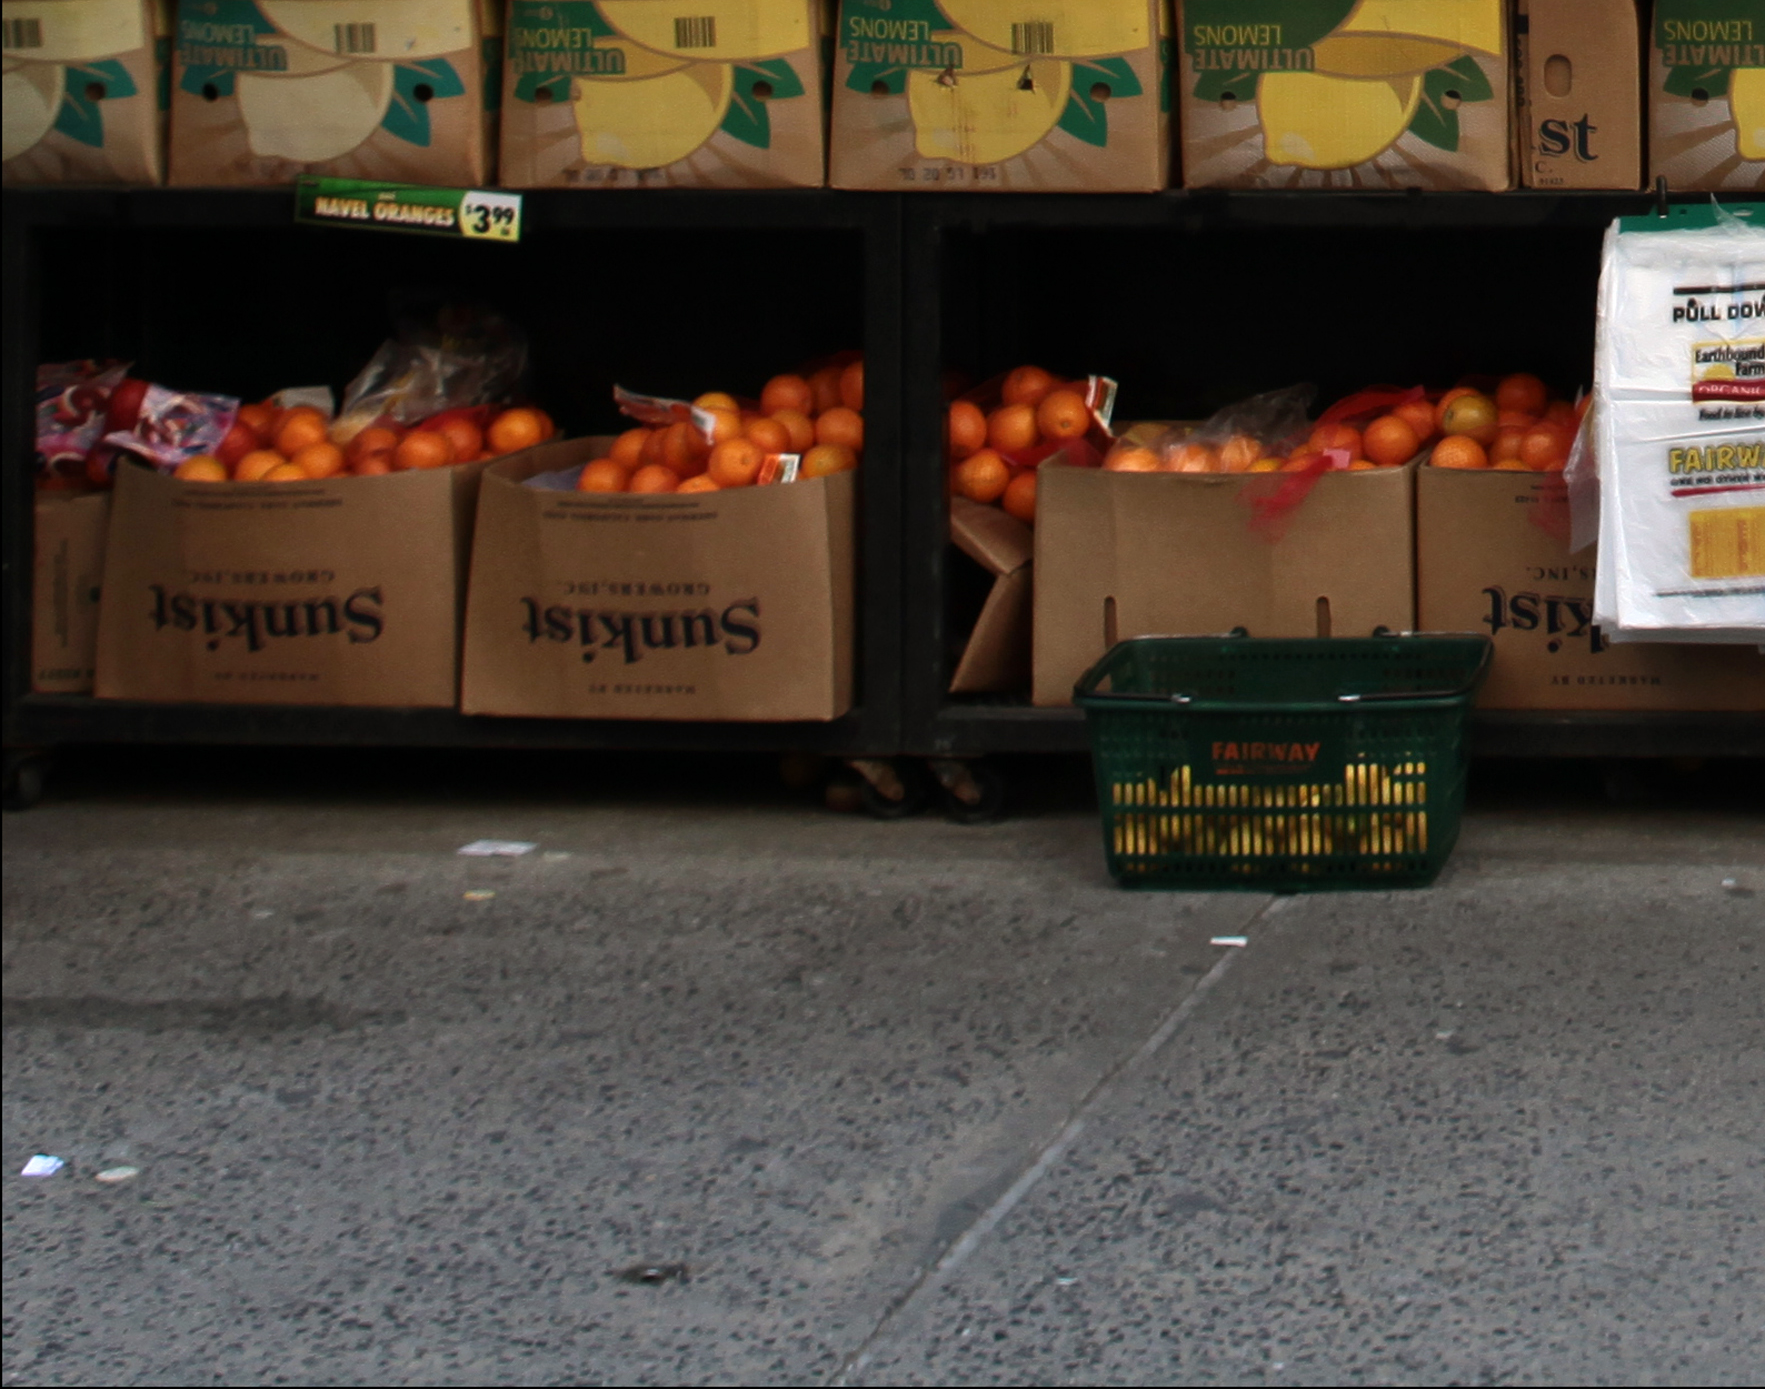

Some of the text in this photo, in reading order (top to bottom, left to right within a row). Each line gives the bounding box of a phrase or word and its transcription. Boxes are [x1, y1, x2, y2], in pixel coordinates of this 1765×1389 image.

[849, 16, 930, 41] LEMONS
[1193, 24, 1282, 47] LEMONS
[1663, 20, 1754, 41] LEMONS
[848, 40, 960, 66] ULTIMATE
[1194, 48, 1312, 70] ULTIMATE
[314, 196, 370, 220] NAVEL
[372, 201, 456, 228] ORANGES
[1695, 344, 1765, 365] Earthbound
[1734, 360, 1765, 378] Farm
[149, 584, 385, 653] Sunkist
[518, 597, 761, 665] Sunkist
[1211, 741, 1322, 762] FAIRWAY
